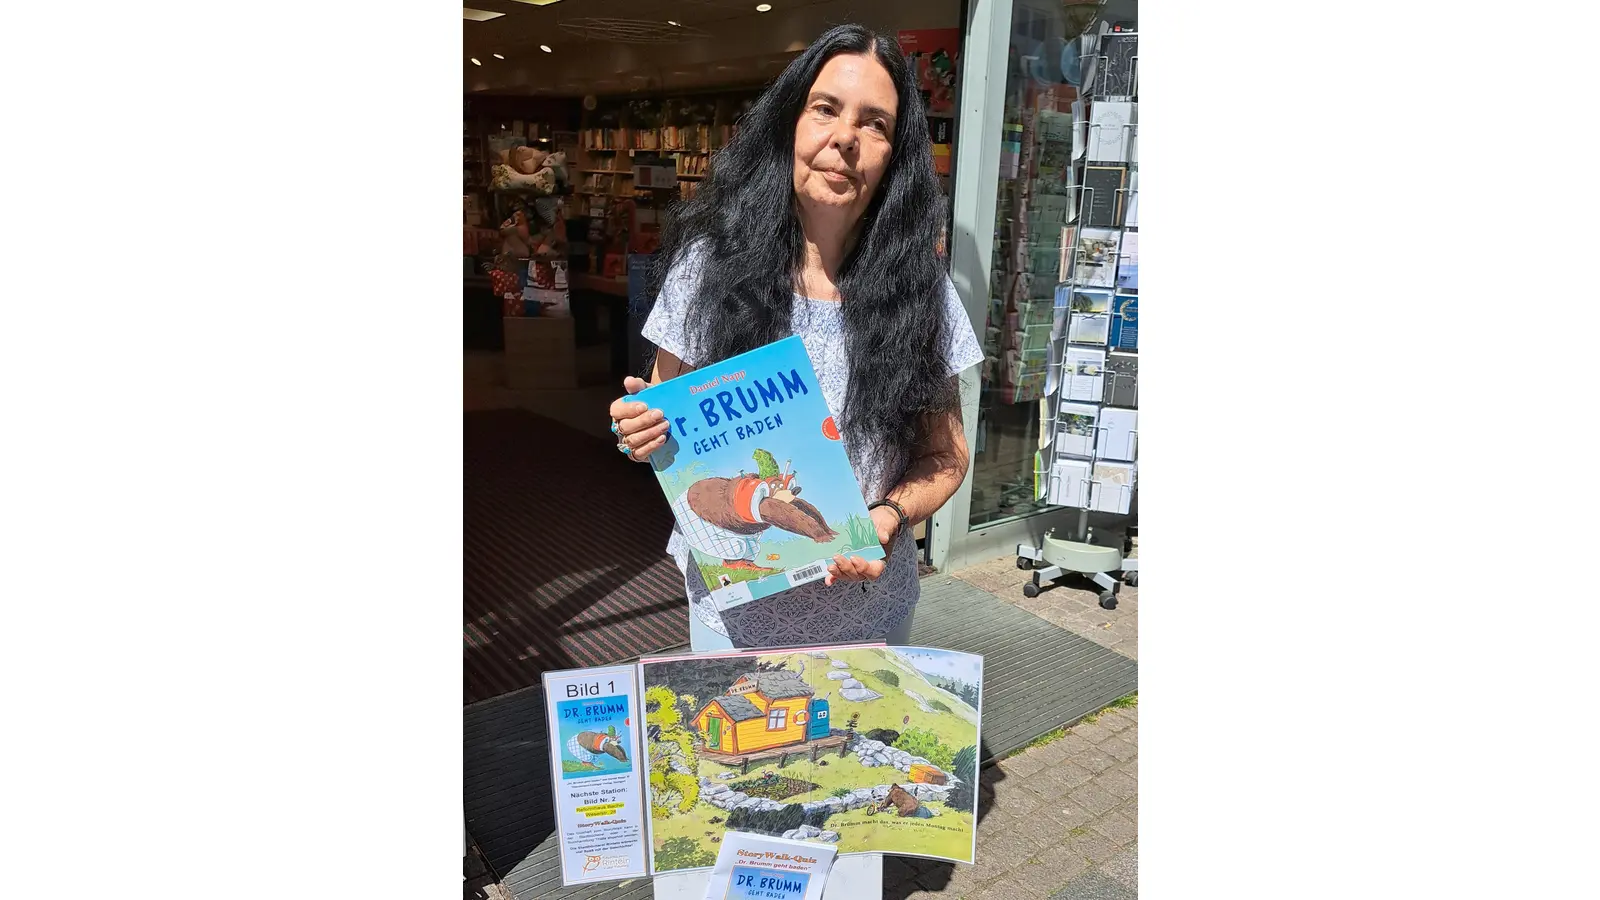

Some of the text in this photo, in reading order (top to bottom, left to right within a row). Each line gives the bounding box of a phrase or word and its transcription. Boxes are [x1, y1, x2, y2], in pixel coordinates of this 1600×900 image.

[689, 369, 747, 395] Daniel Napp
[699, 368, 809, 428] BRUMM
[693, 413, 784, 455] GEHT BADEN
[566, 680, 615, 698] Bild 1
[564, 703, 625, 719] DR. BRUMM
[925, 823, 946, 831] Montag
[737, 848, 818, 864] StoryWalk-Quiz
[773, 861, 788, 869] geht
[737, 874, 756, 888] DR.
[759, 877, 802, 894] BRUMM
[765, 891, 786, 900] BADEN
